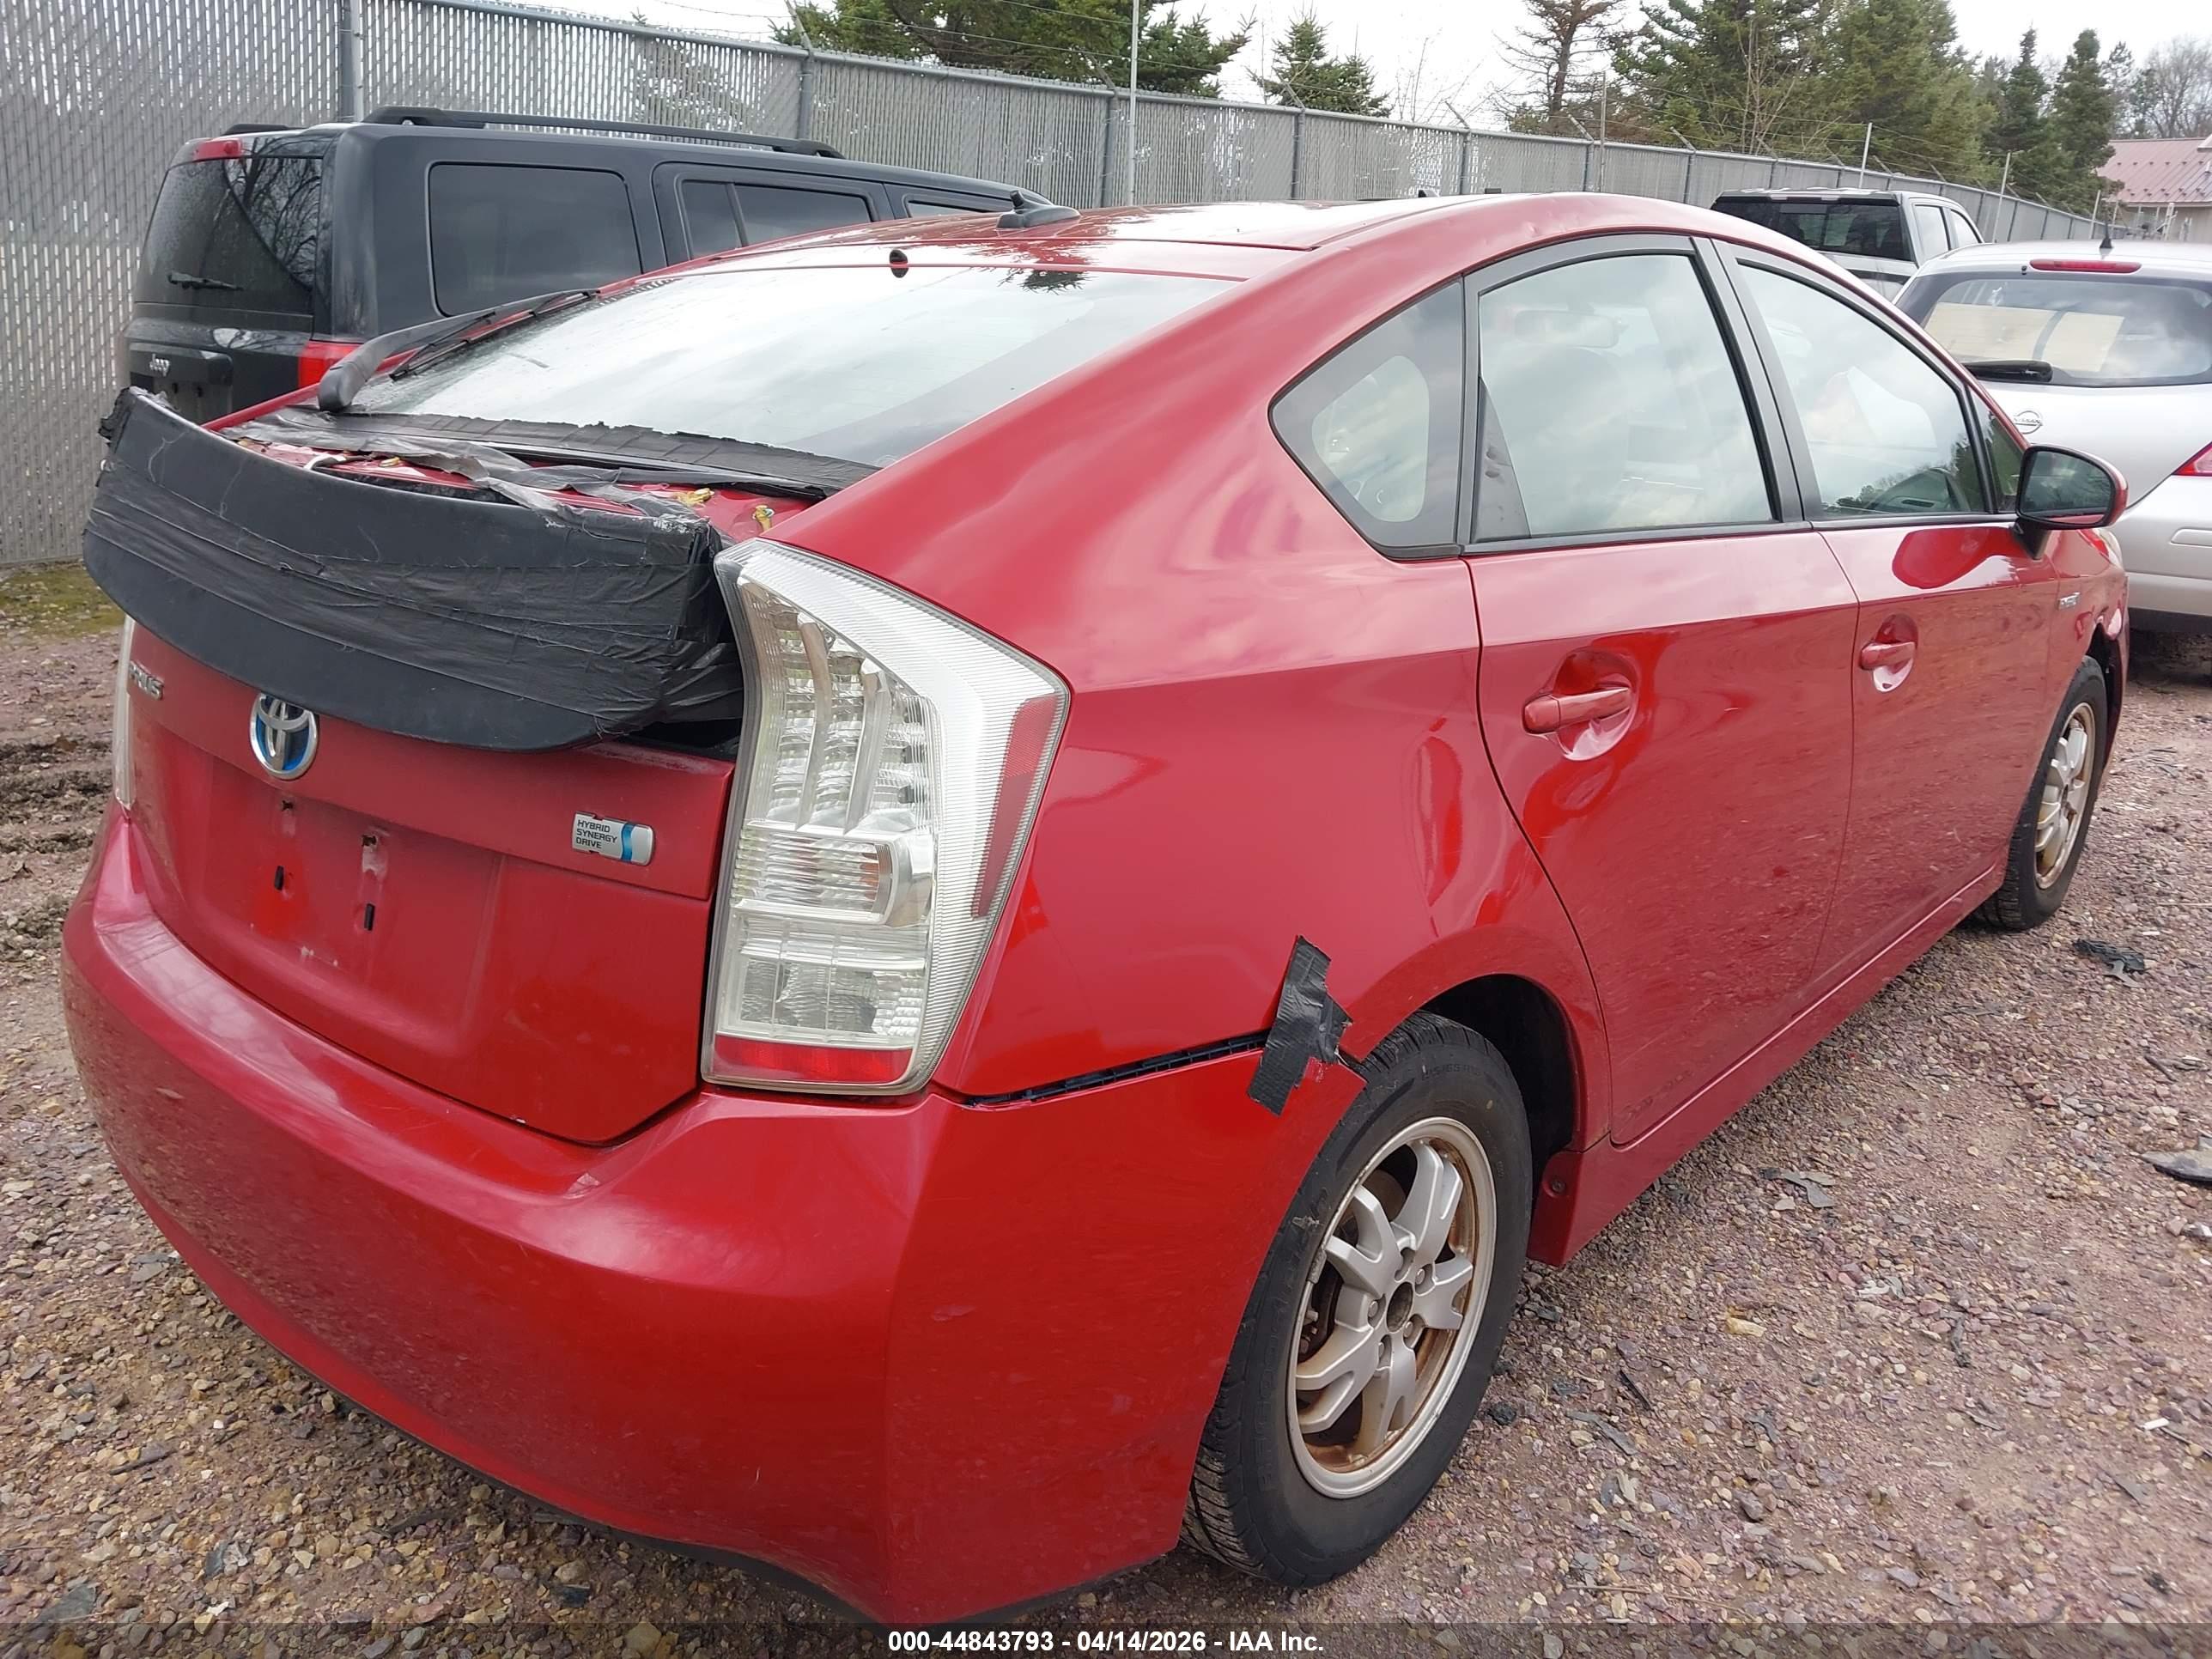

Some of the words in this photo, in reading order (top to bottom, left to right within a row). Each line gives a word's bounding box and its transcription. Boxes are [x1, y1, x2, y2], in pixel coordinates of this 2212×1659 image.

[577, 819, 611, 833] HYBRID
[575, 836, 602, 849] DRIVE
[576, 828, 618, 843] SYNERGY
